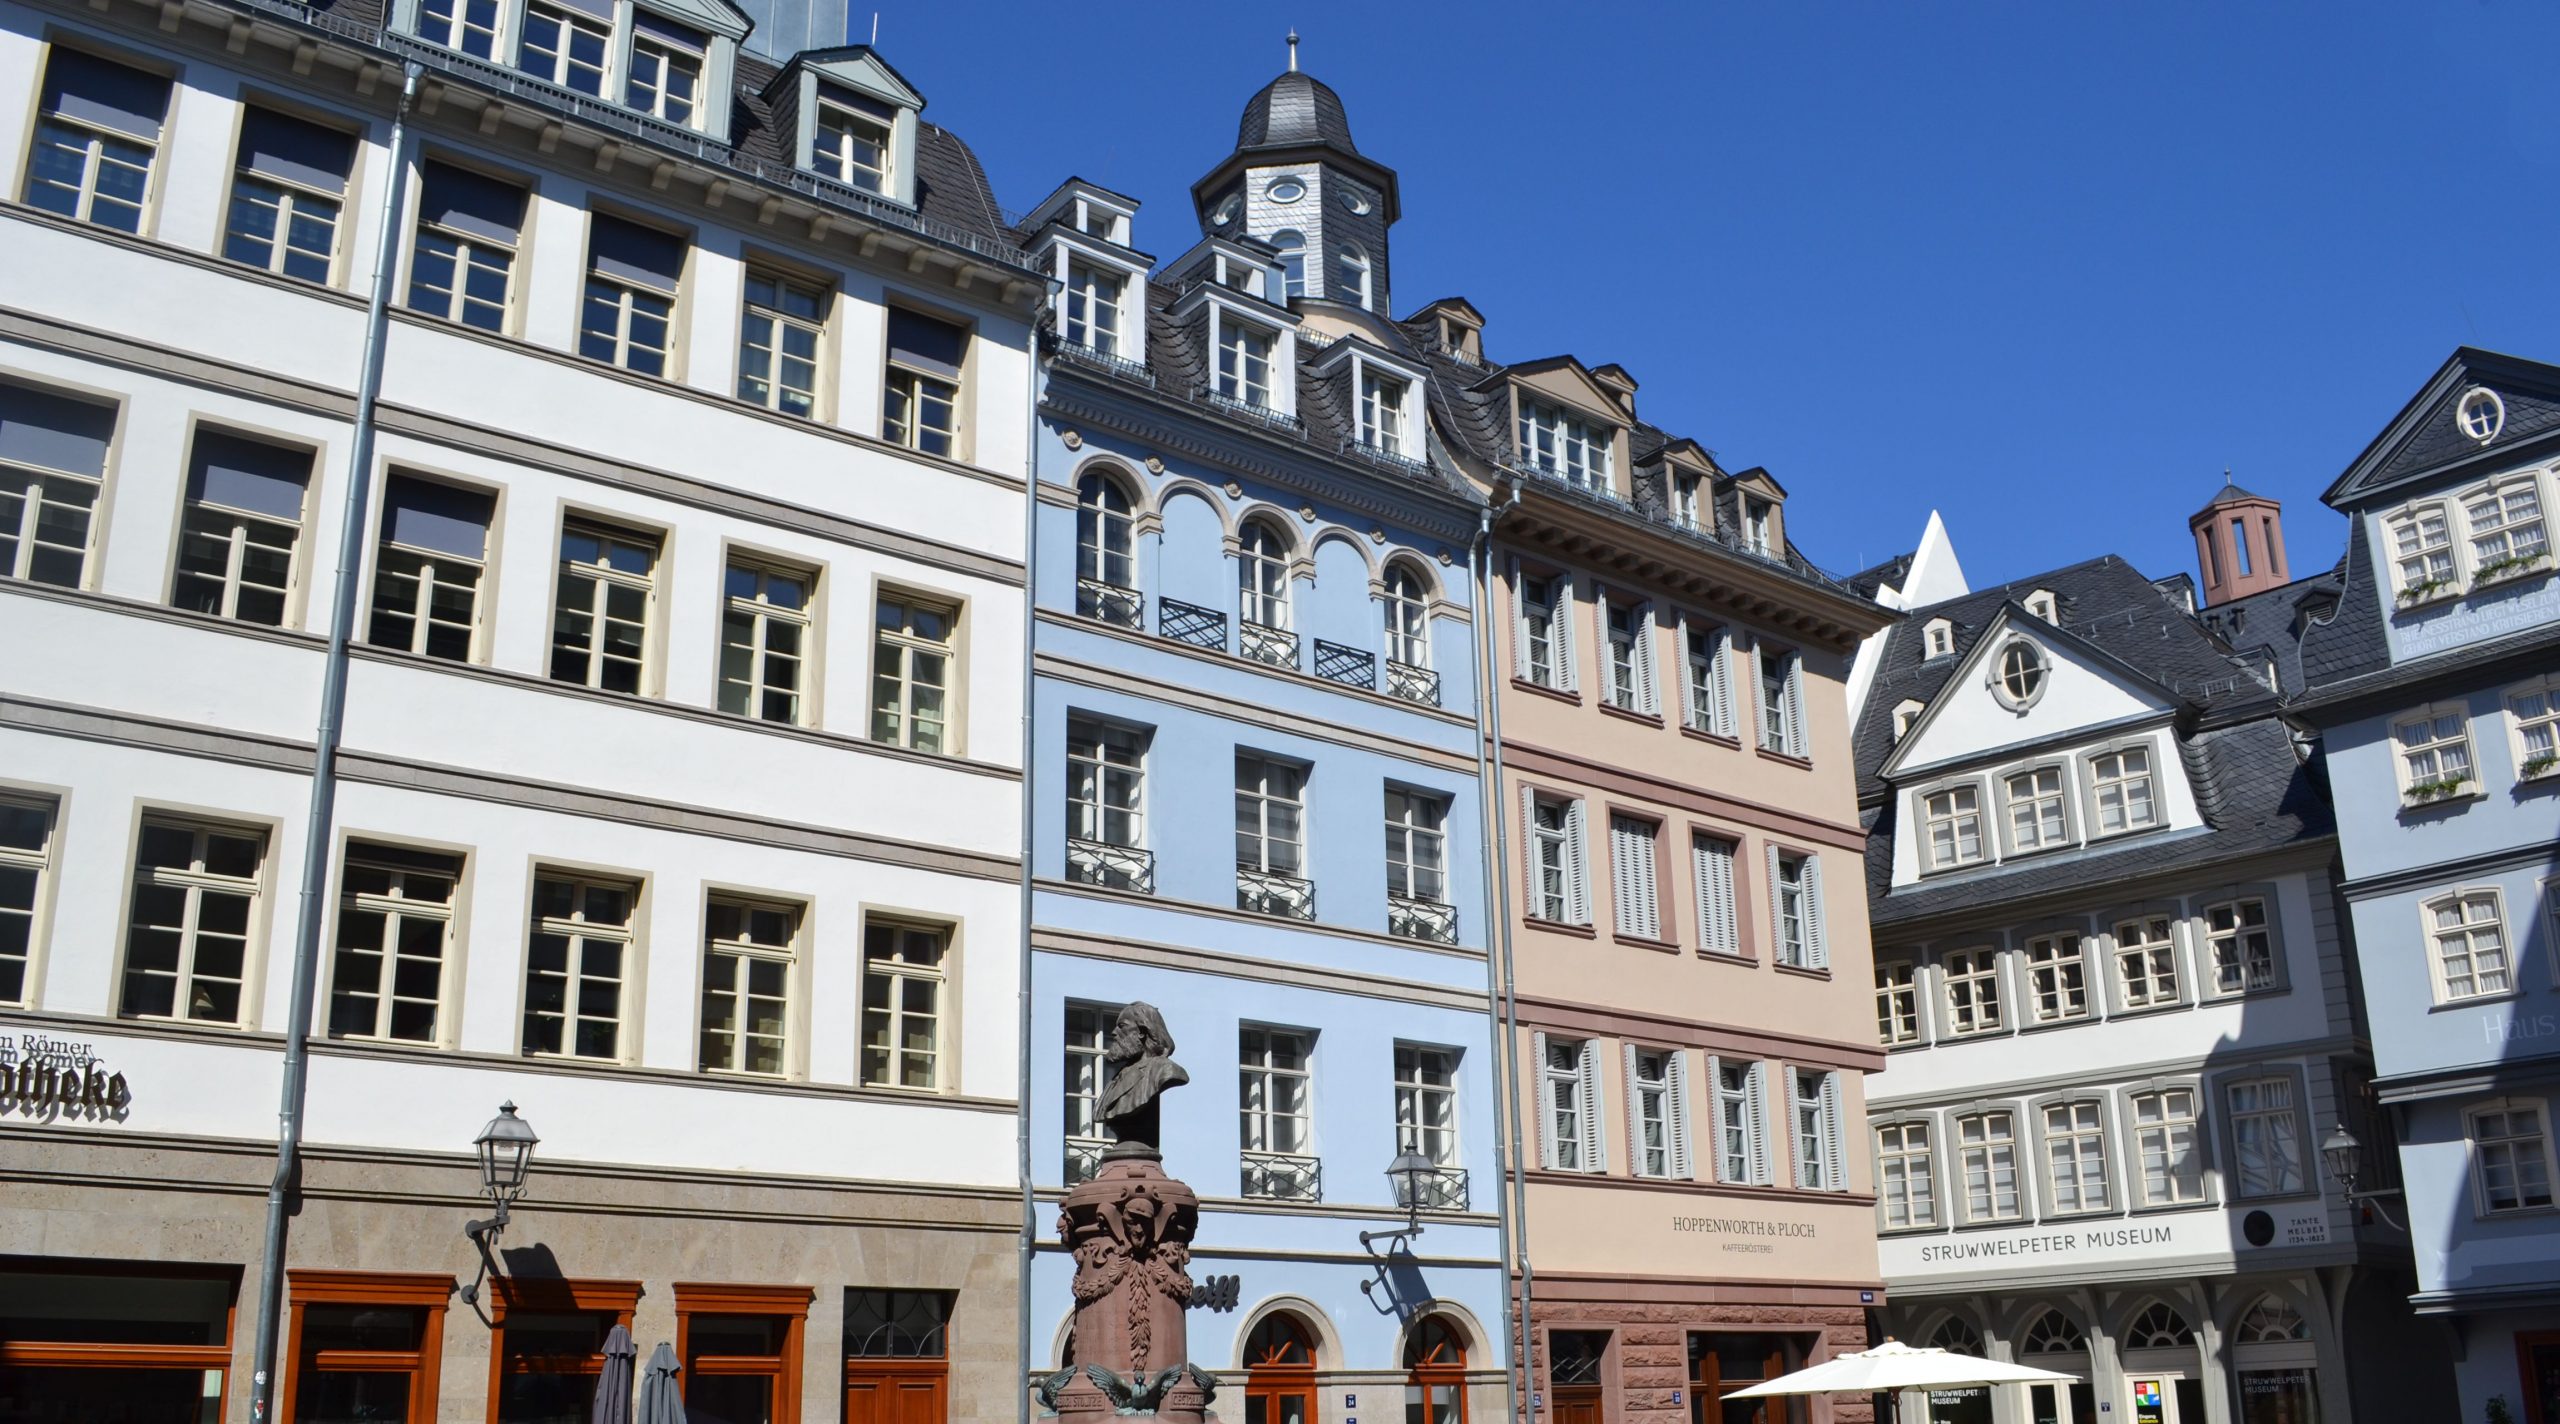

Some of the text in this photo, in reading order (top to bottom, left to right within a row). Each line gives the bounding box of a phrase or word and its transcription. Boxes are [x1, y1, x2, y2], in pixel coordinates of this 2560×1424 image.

[2481, 605, 2506, 622] LIEGT
[2506, 598, 2537, 613] WESEL
[2439, 623, 2490, 645] VERSTAND
[2492, 606, 2554, 632] KRITISIEREN
[2482, 1014, 2556, 1044] Haus
[21, 1034, 92, 1055] Römer
[0, 1058, 129, 1113] otheke
[1673, 1216, 1816, 1238] HOPPENWORTH & PLOCH
[2287, 1225, 2324, 1236] MELBER
[2290, 1217, 2320, 1226] TANTE
[1722, 1242, 1774, 1254] KAFFEERÖSTEREI
[1921, 1226, 2172, 1262] STRUWWELPETER MUSEUM
[1187, 1275, 1240, 1313] eiff
[2243, 1375, 2311, 1386] STRUWWELPETER
[2245, 1385, 2280, 1393] MUSEUM
[1931, 1397, 1961, 1405] MUSEUM
